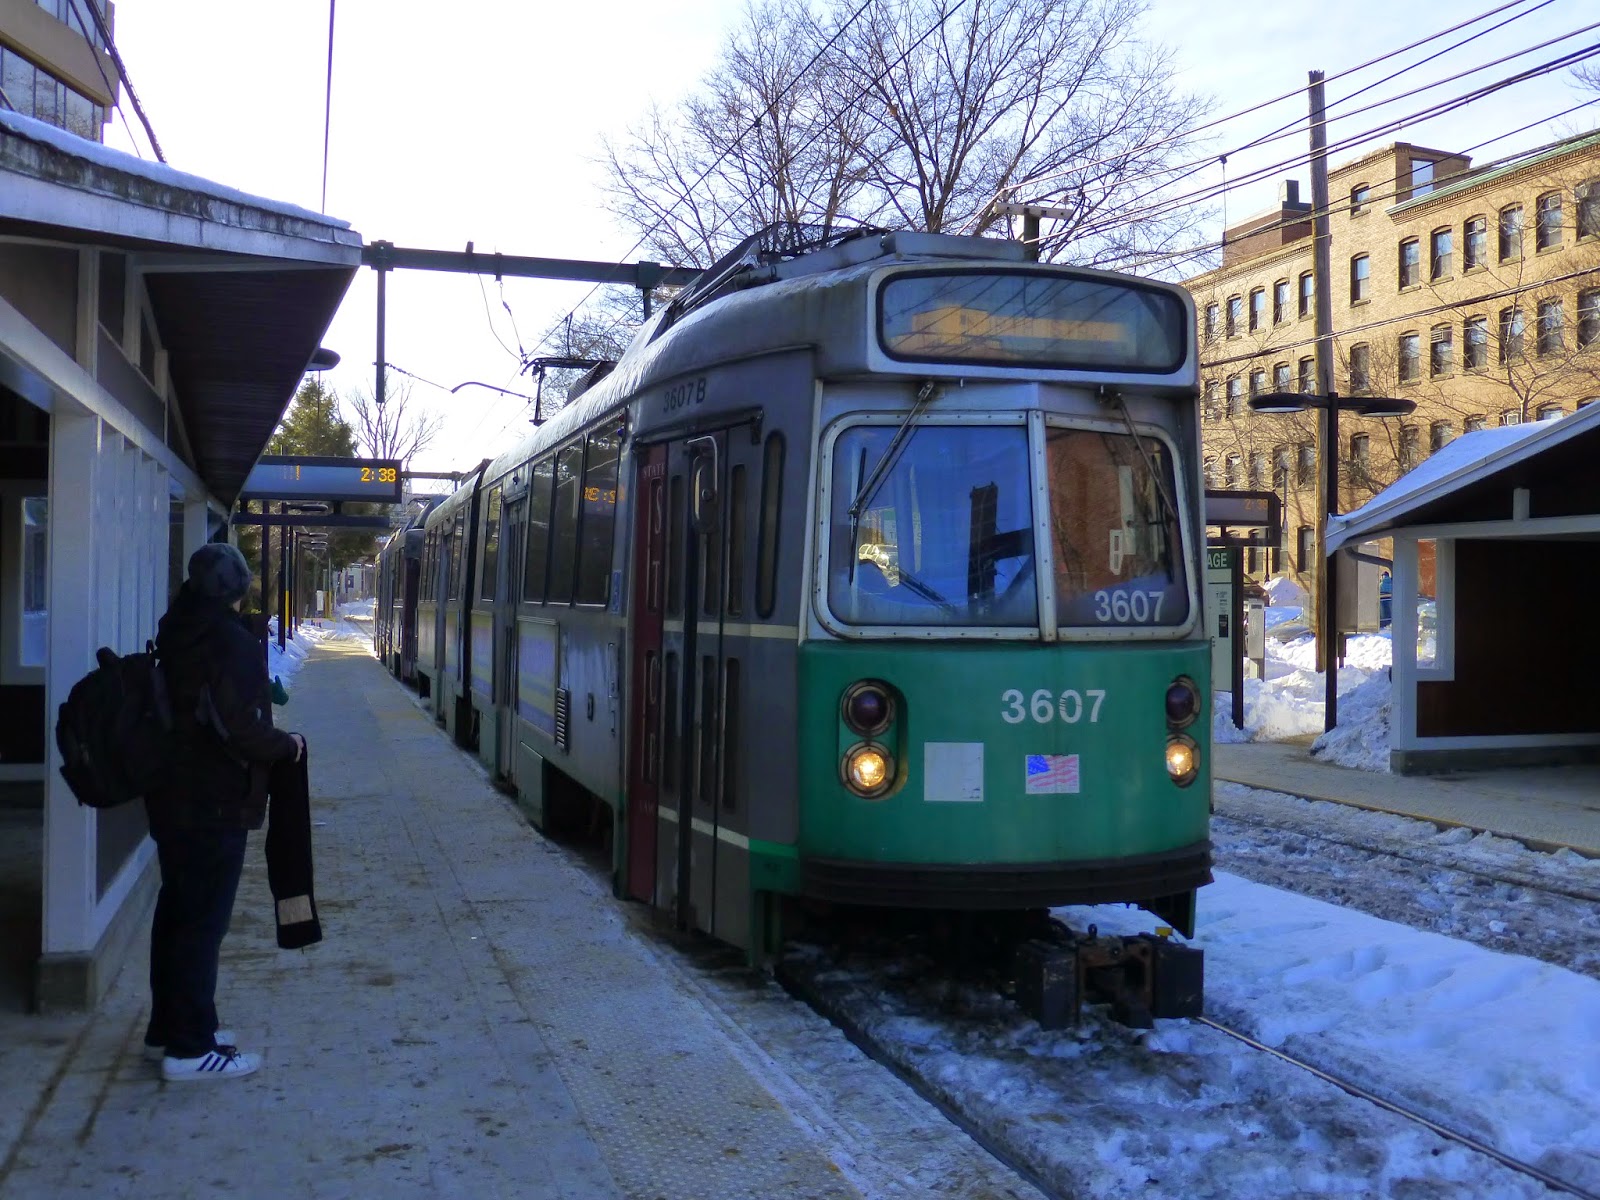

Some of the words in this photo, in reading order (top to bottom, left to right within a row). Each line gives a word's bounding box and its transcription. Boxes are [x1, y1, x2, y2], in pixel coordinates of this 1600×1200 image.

[664, 378, 706, 412] 3607B
[361, 467, 396, 482] 2:38
[642, 463, 665, 479] STATE
[1094, 589, 1165, 623] 3607
[1001, 688, 1106, 724] 3607
